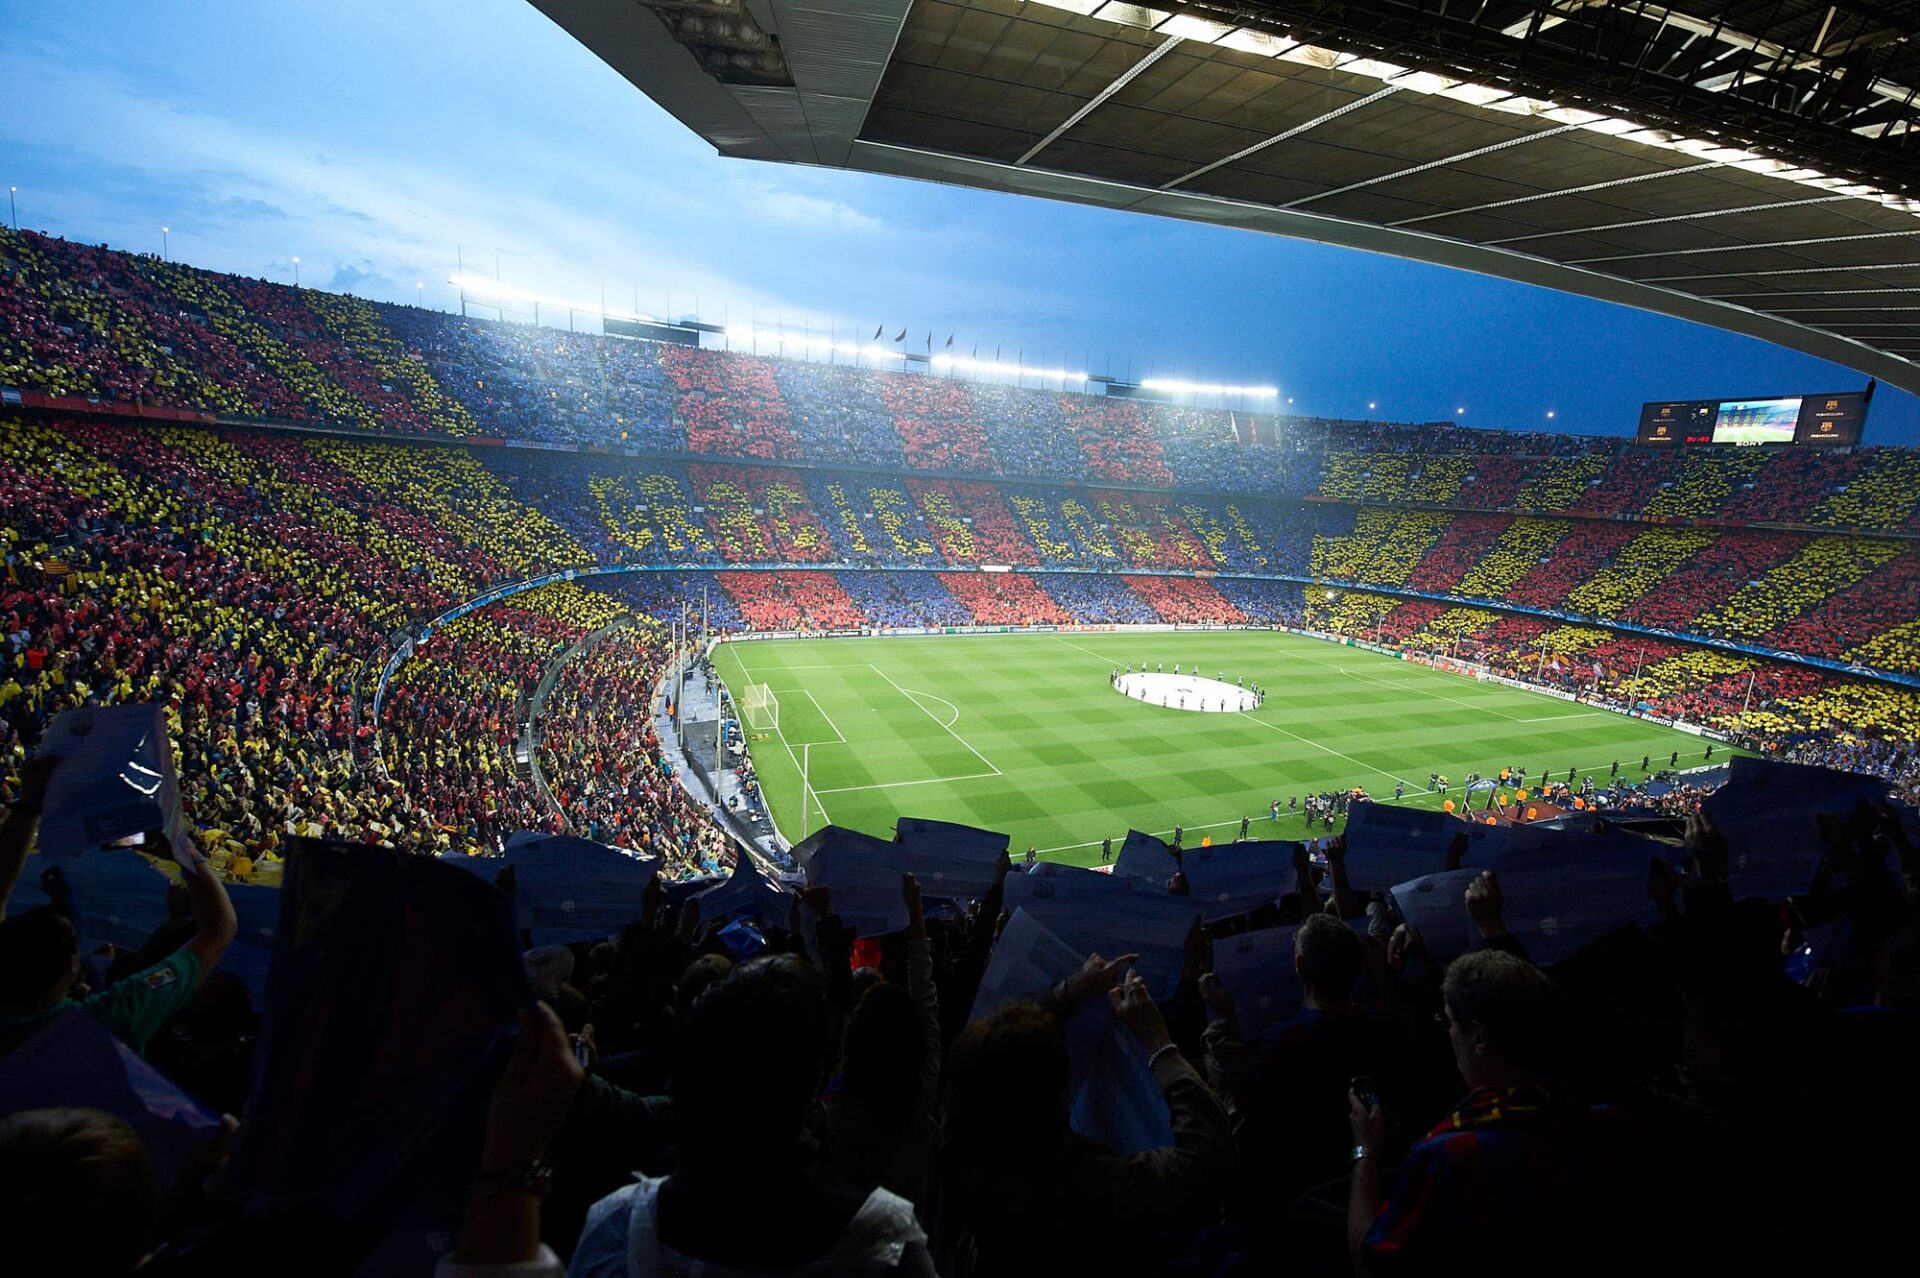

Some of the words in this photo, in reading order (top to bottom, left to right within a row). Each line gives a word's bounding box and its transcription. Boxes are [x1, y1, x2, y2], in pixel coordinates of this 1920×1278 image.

[800, 630, 827, 638] SONY
[1533, 686, 1567, 698] UniCredit
[1587, 698, 1629, 715] MasterCard
[1640, 712, 1672, 727] Maestro
